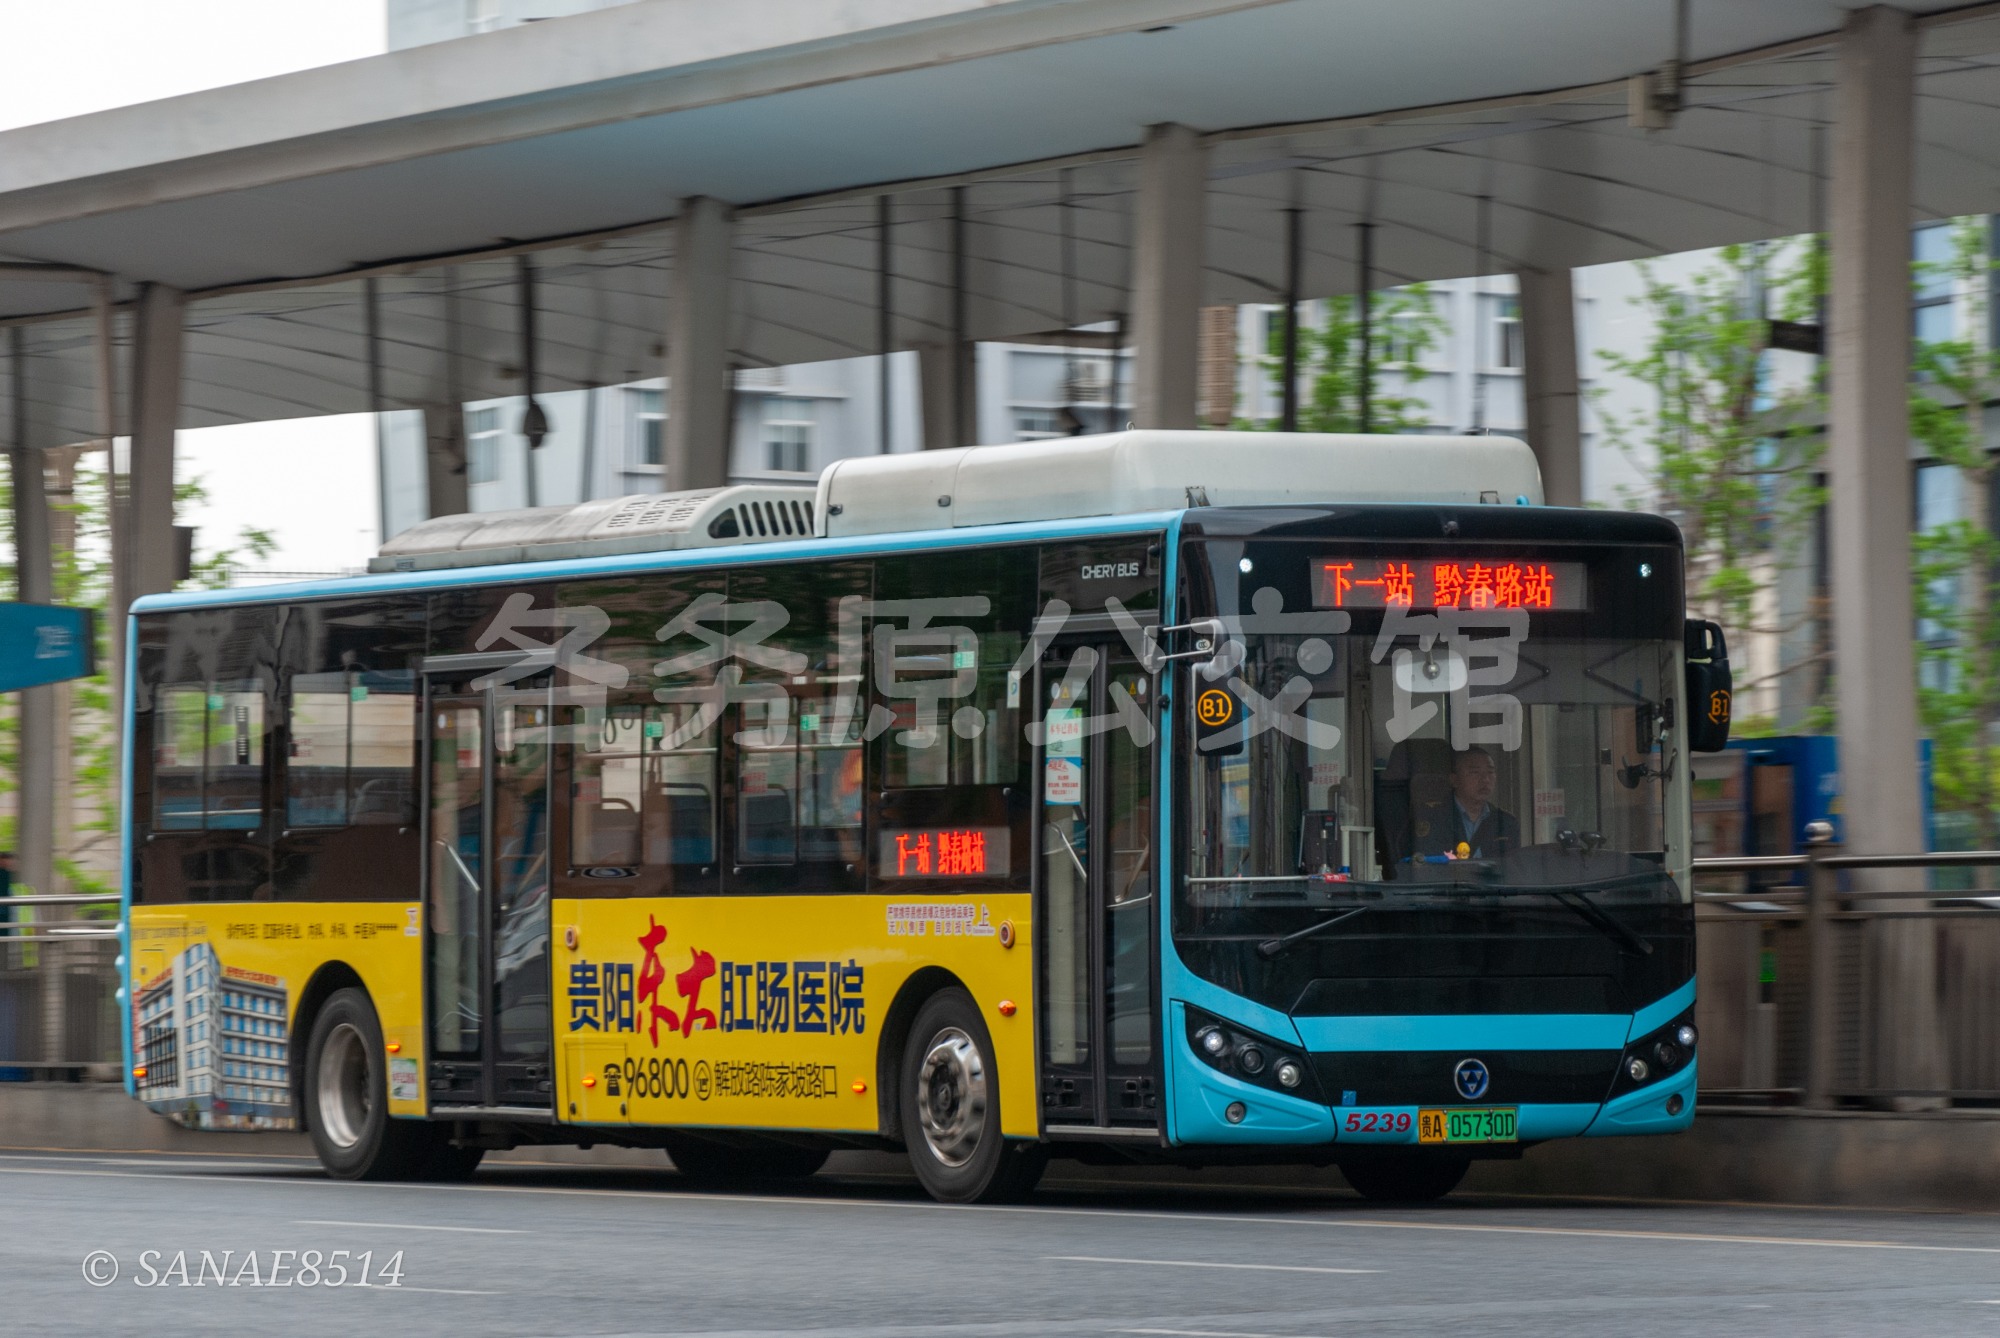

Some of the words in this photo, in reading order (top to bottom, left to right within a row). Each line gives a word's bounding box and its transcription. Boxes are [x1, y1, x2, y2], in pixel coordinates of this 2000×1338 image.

[1081, 563, 1117, 580] CHERY
[1117, 562, 1140, 578] BUS
[1325, 562, 1415, 607] 下一站
[1434, 562, 1554, 608] 黔春路站
[1203, 698, 1226, 718] B1
[1711, 697, 1729, 717] B1
[1049, 723, 1079, 735] 本车已消毒
[896, 832, 931, 877] 下一站
[937, 830, 986, 875] 黔春路站
[979, 905, 989, 927] 上
[567, 913, 865, 1048] 贵阳东大肛肠医院
[624, 1056, 689, 1099] 96800
[713, 1059, 838, 1100] 解放路陈家坡路口
[1344, 1112, 1412, 1133] 5239
[1451, 1112, 1515, 1138] 05730D
